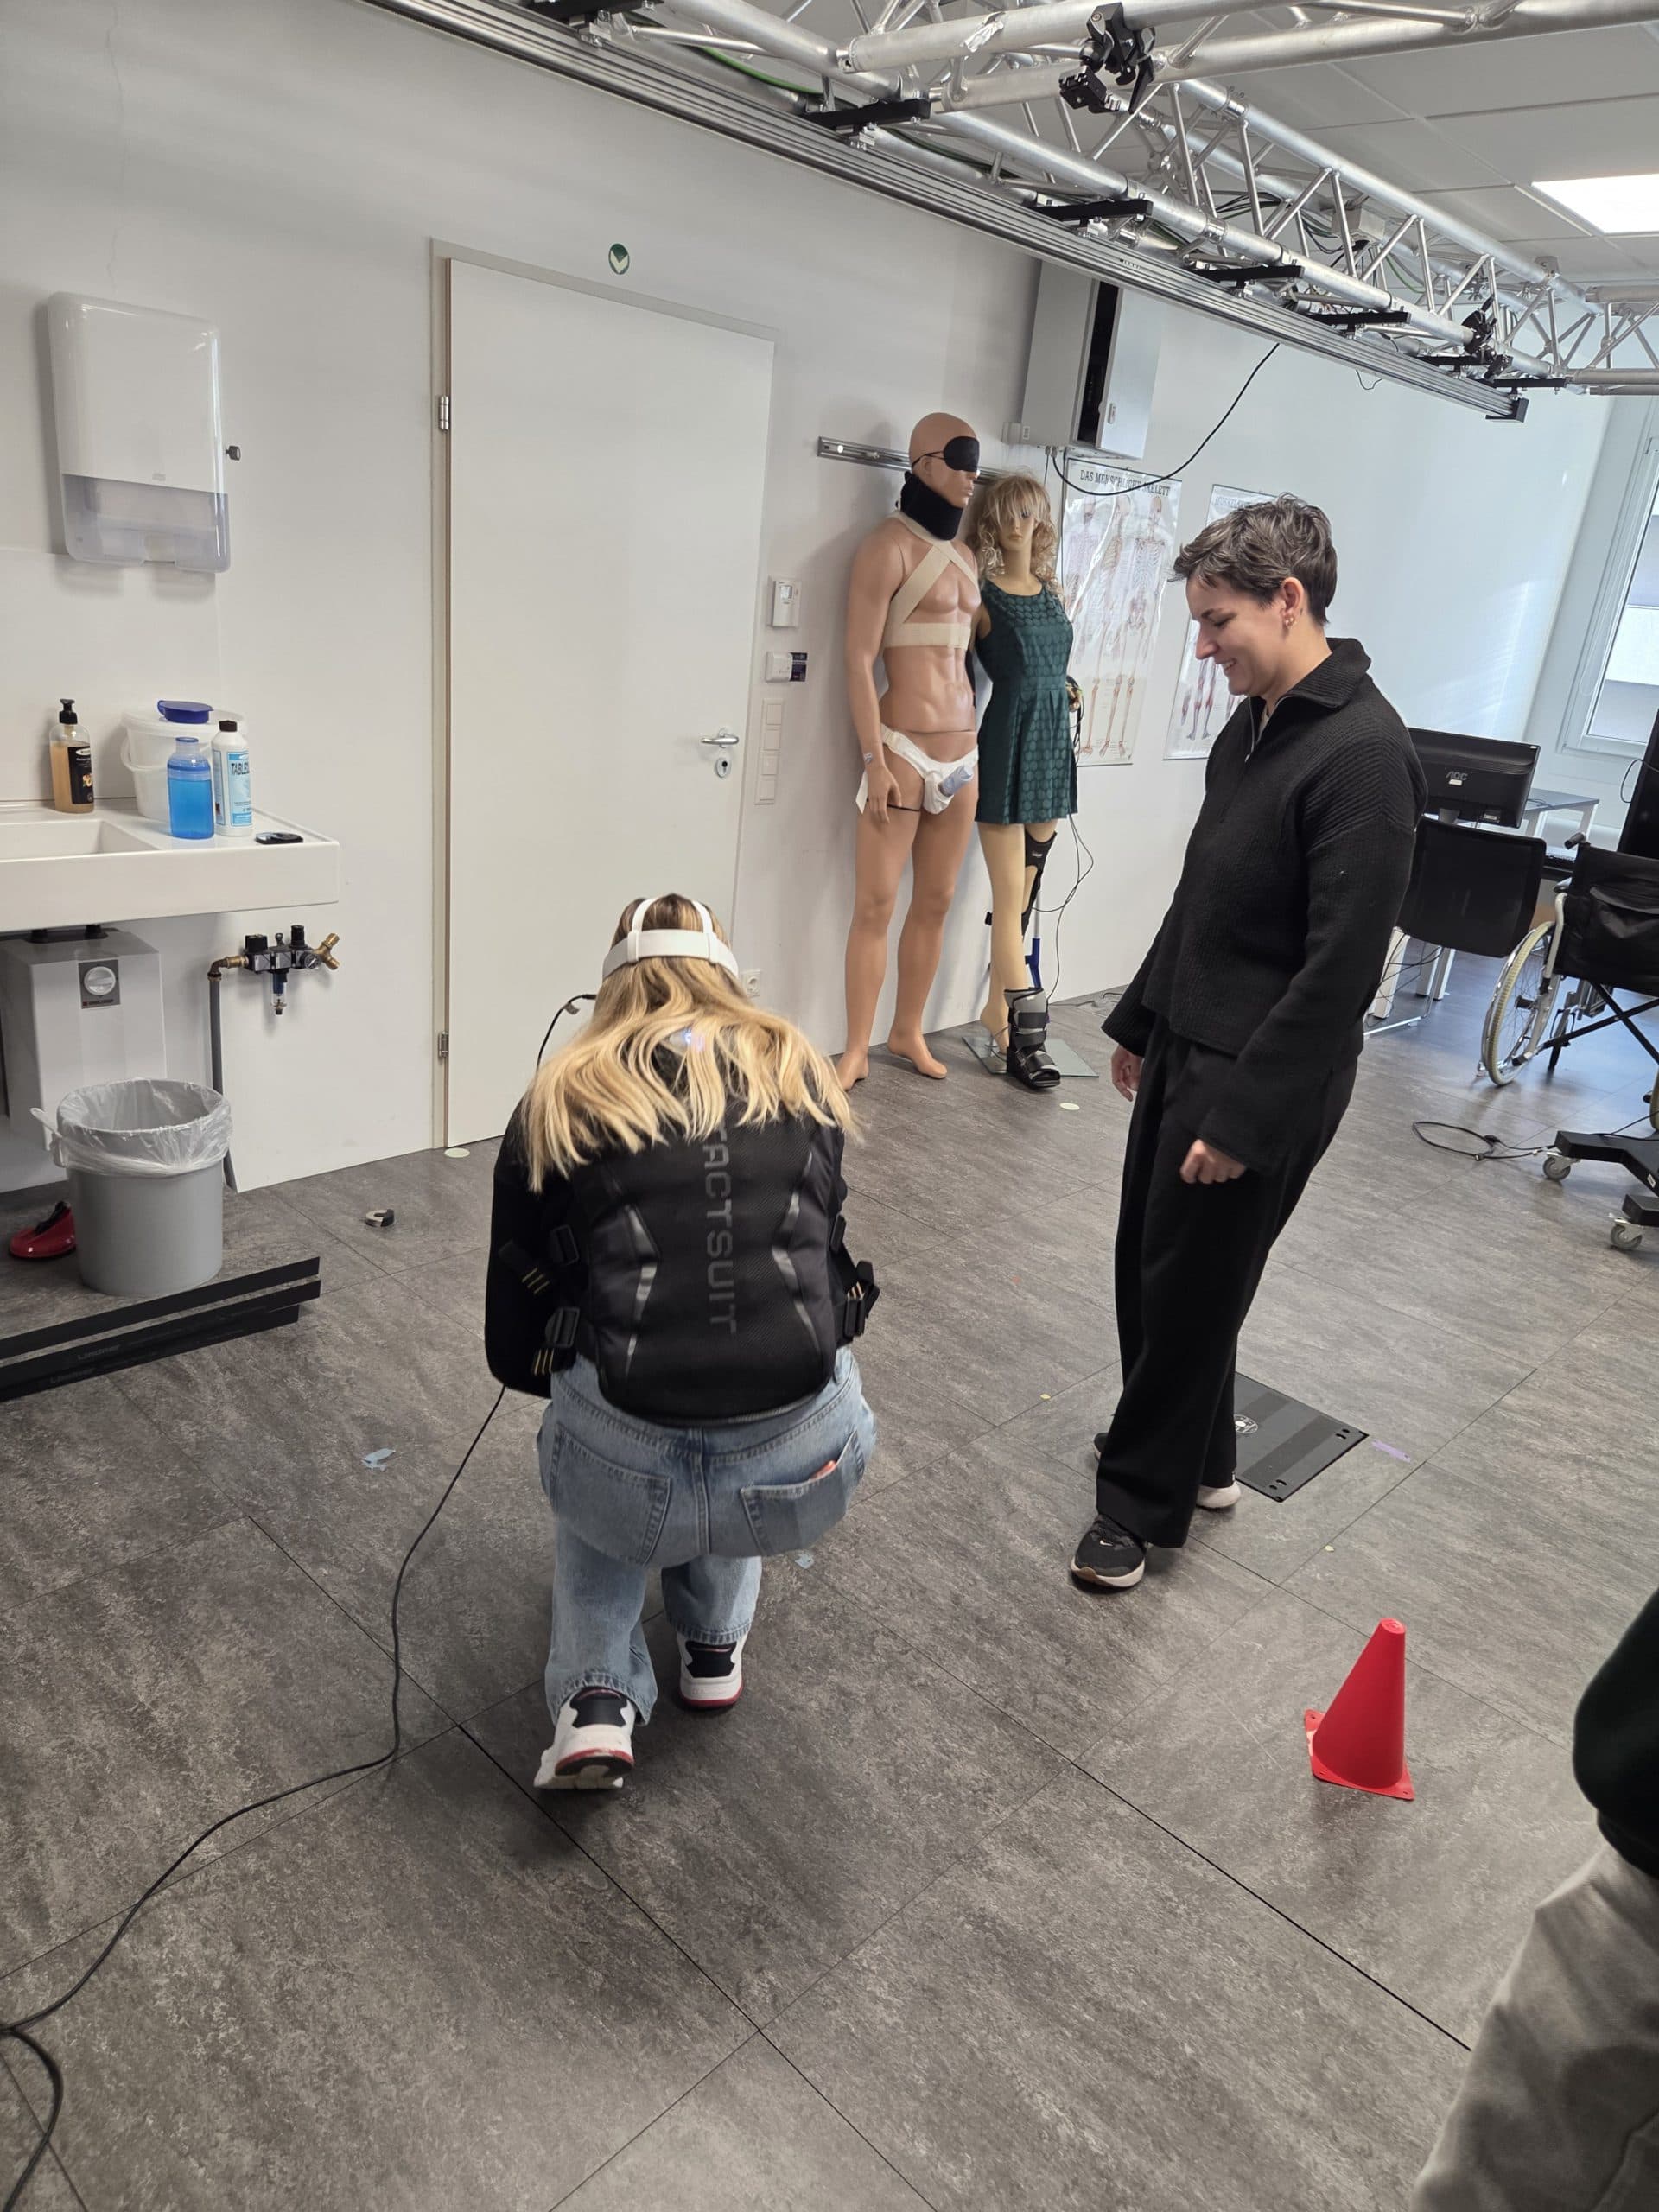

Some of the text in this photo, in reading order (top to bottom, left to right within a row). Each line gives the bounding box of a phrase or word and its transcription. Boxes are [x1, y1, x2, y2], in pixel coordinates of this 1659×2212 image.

[1080, 469, 1094, 482] DAS
[1142, 482, 1171, 497] KELETT
[1446, 771, 1468, 781] AOC
